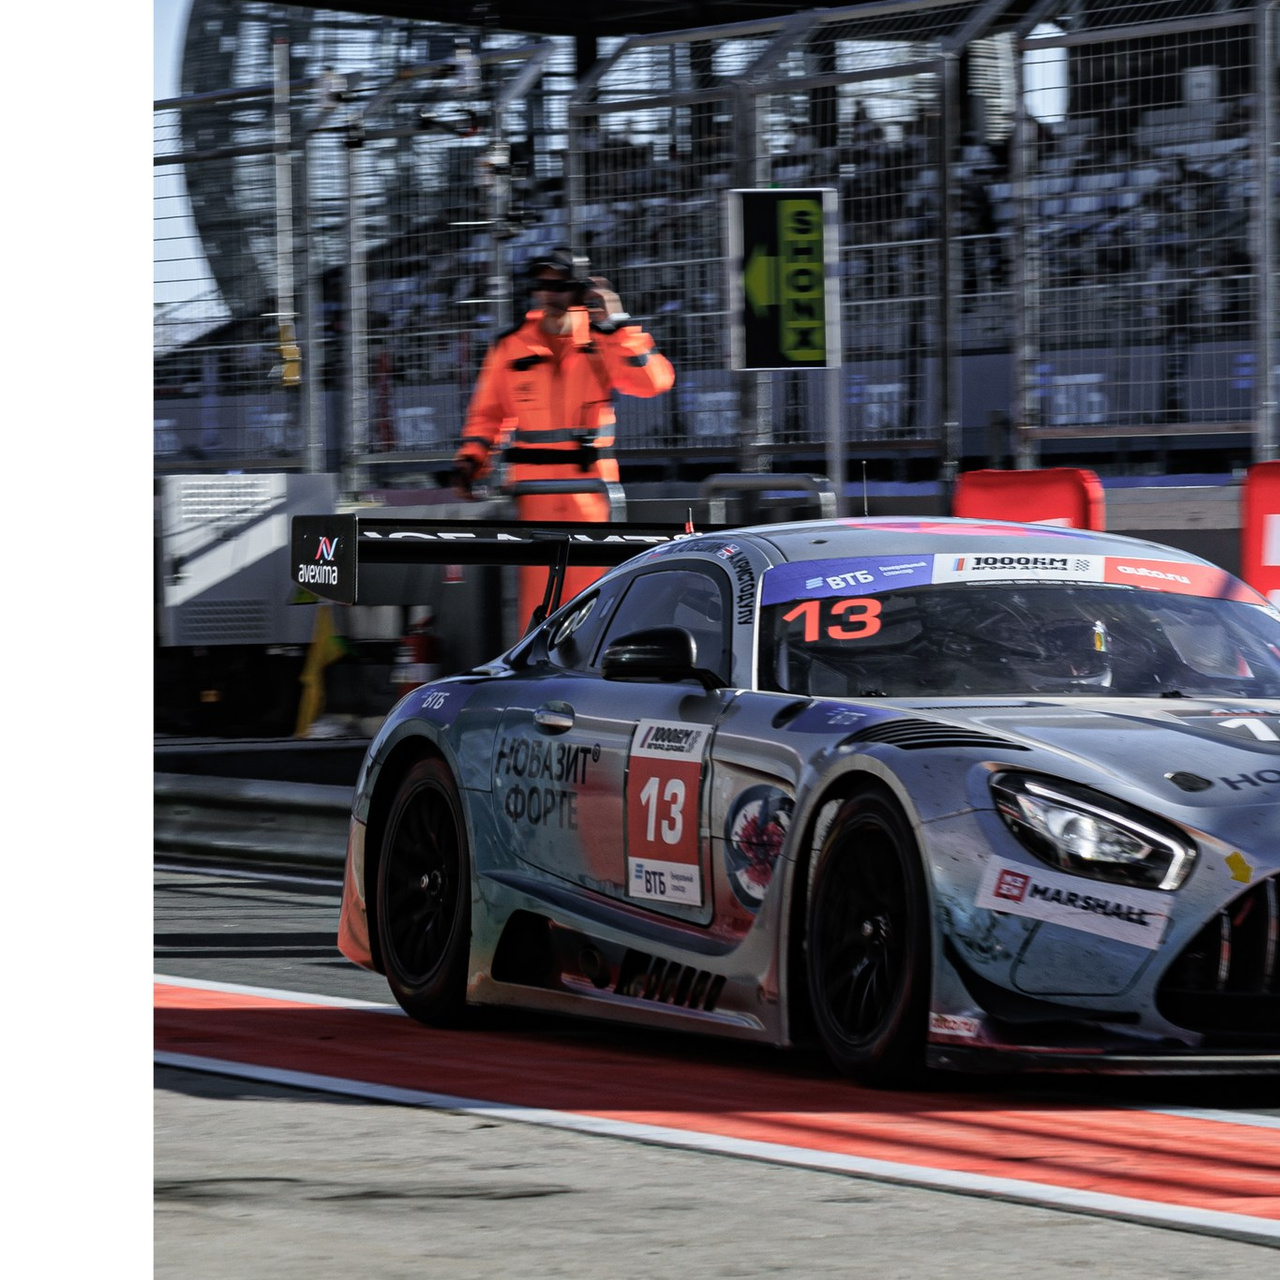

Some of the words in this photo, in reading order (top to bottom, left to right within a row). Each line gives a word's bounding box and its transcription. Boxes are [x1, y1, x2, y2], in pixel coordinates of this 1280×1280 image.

[298, 560, 338, 586] avexima
[825, 570, 875, 590] ВТБ
[1116, 565, 1191, 585] auto.ru
[782, 597, 882, 643] 13
[422, 692, 450, 709] ВТБ
[505, 783, 578, 831] ФОРТЕ
[639, 776, 687, 845] 13
[645, 869, 666, 895] ВТБ
[1028, 883, 1150, 927] MARSHALL
